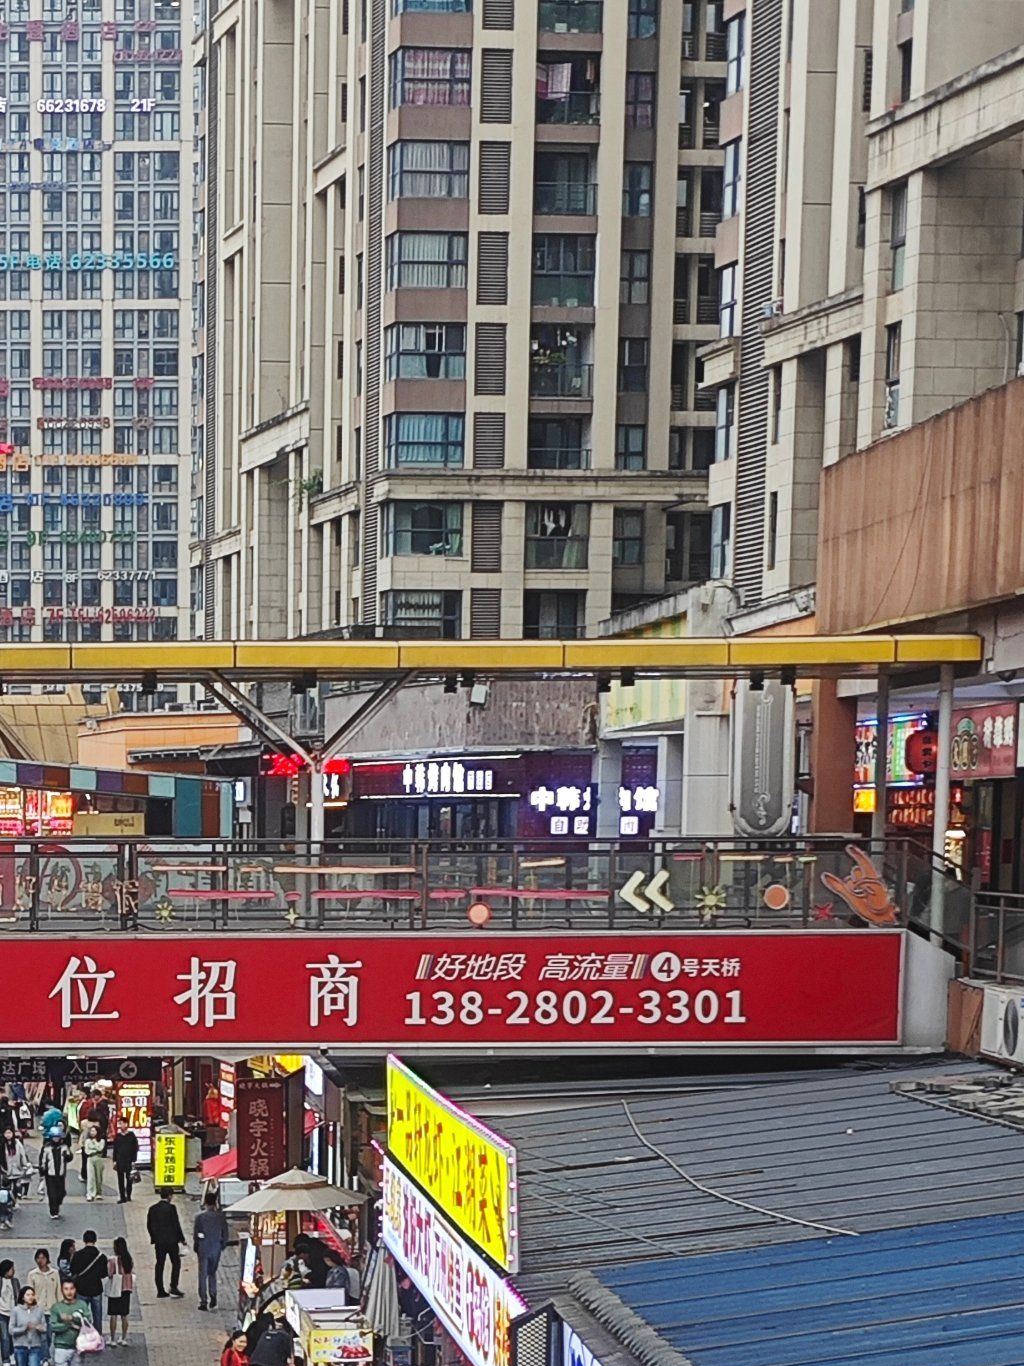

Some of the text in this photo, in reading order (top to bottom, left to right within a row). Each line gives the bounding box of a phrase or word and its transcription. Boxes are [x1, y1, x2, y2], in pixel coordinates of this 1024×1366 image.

[37, 99, 106, 112] 66231678
[130, 99, 156, 111] 21F
[433, 953, 527, 982] 好地段
[538, 953, 635, 982] 高流量
[404, 990, 747, 1025] 138-2802-3301
[70, 1061, 98, 1075] 入口
[249, 1099, 270, 1176] 晓宇火锅
